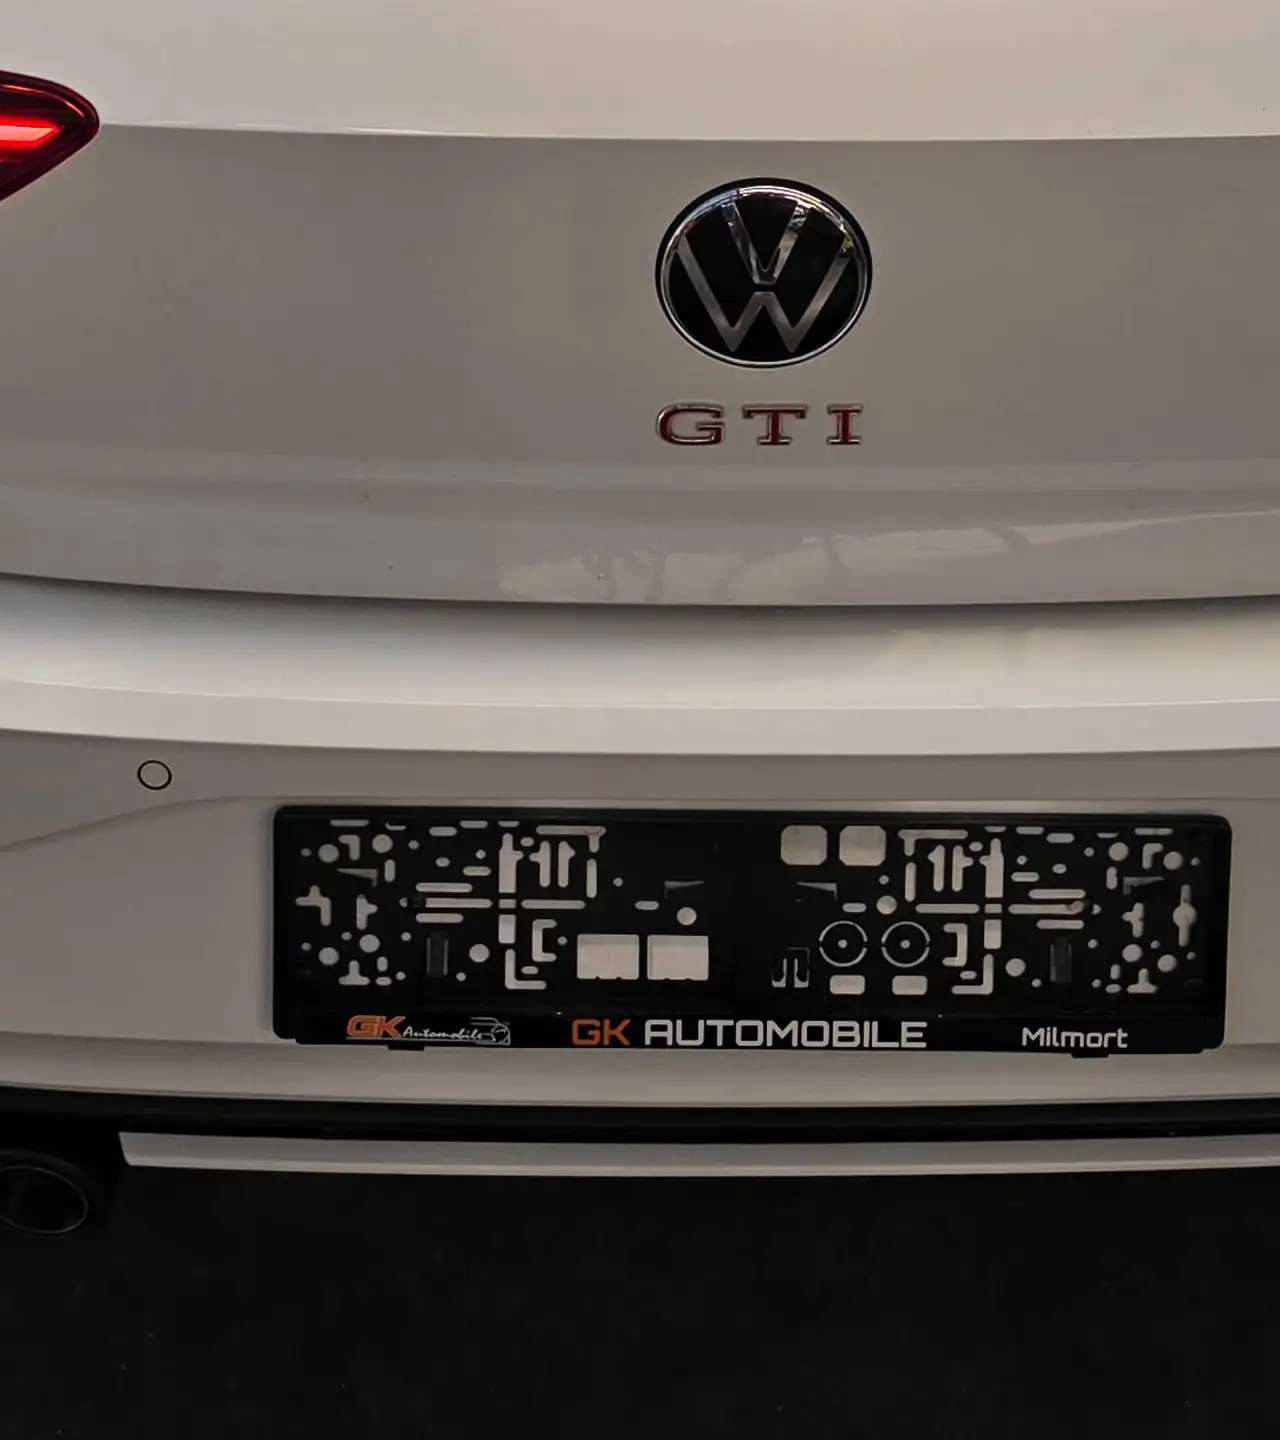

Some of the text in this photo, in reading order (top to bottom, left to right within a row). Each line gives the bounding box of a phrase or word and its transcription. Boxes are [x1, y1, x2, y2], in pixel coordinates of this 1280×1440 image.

[667, 190, 862, 357] VW
[655, 402, 863, 446] GTI
[347, 1015, 483, 1040] GK Automobile
[572, 1019, 928, 1048] GK AUTOMOBILE
[1021, 1026, 1128, 1048] Milmort
